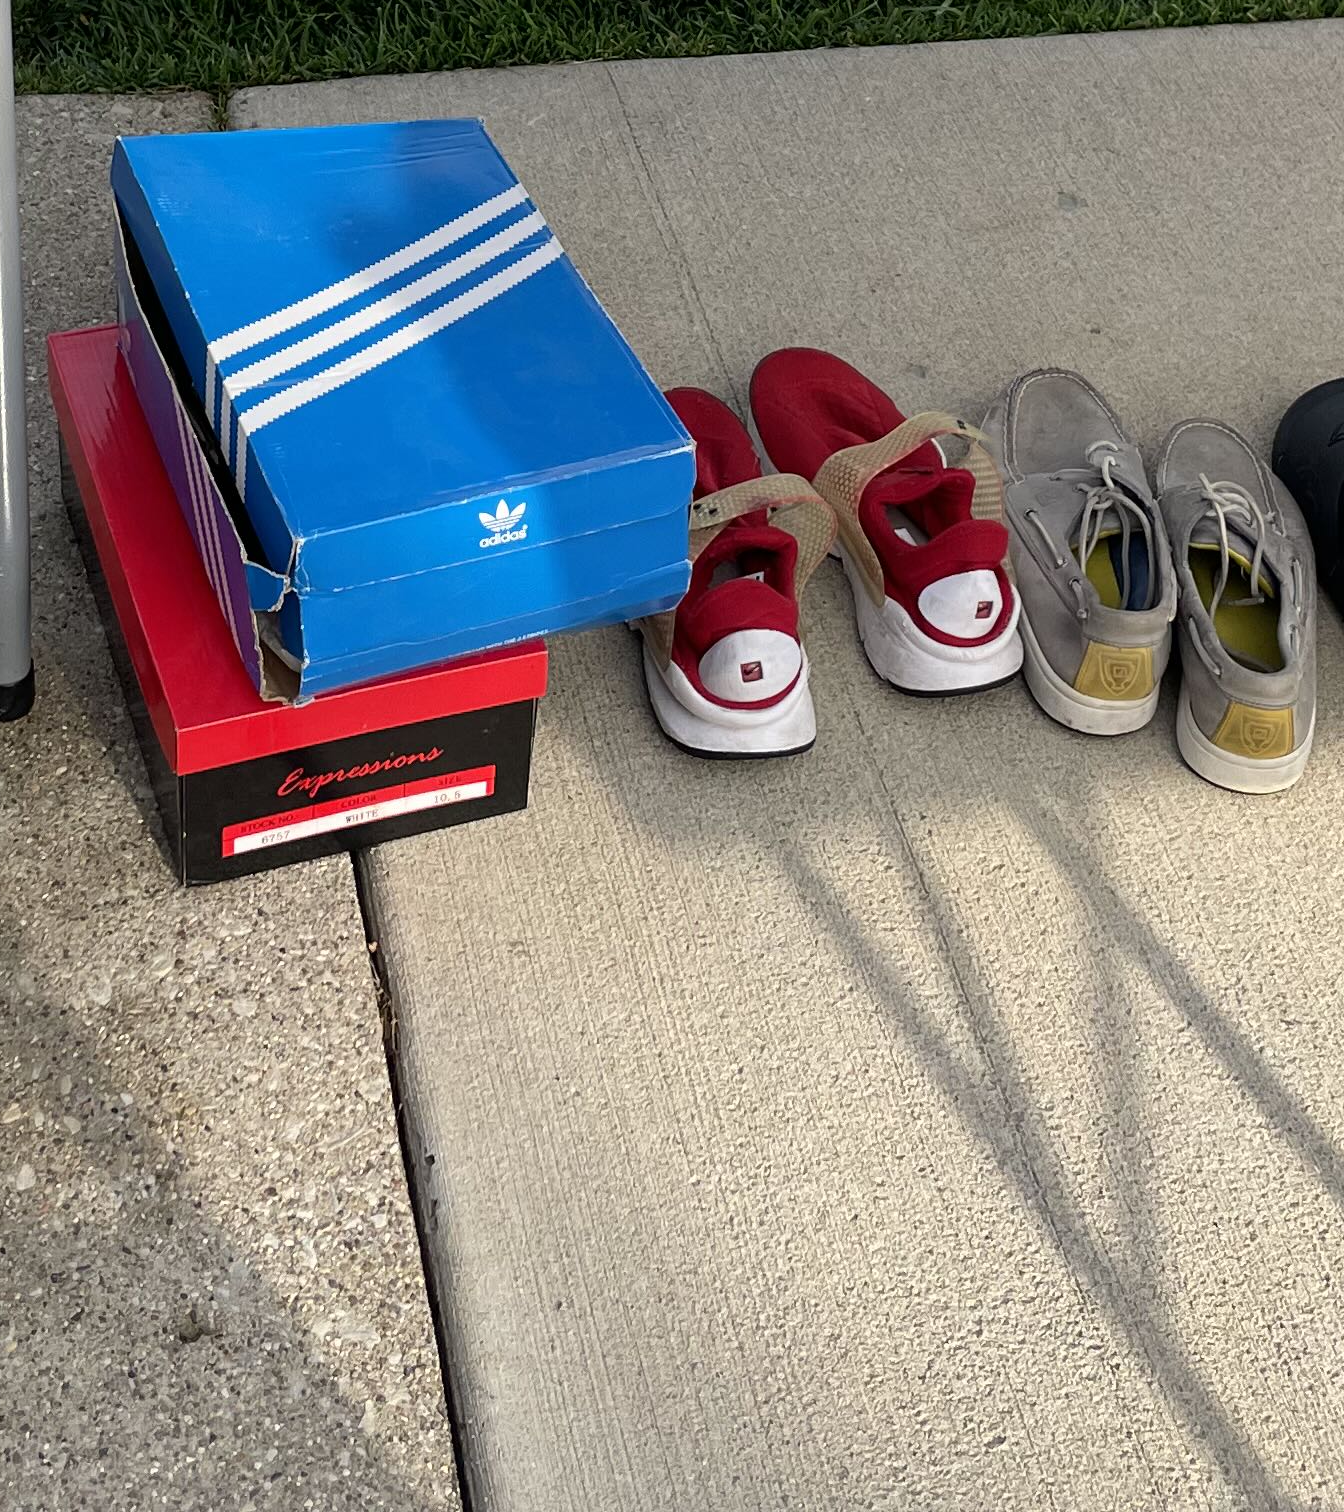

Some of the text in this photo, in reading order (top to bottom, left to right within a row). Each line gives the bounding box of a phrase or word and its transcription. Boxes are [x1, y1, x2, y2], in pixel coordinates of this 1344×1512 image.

[479, 528, 528, 549] adidas
[276, 746, 445, 799] Expressions
[340, 793, 377, 809] COLOR
[345, 808, 379, 824] WHITE
